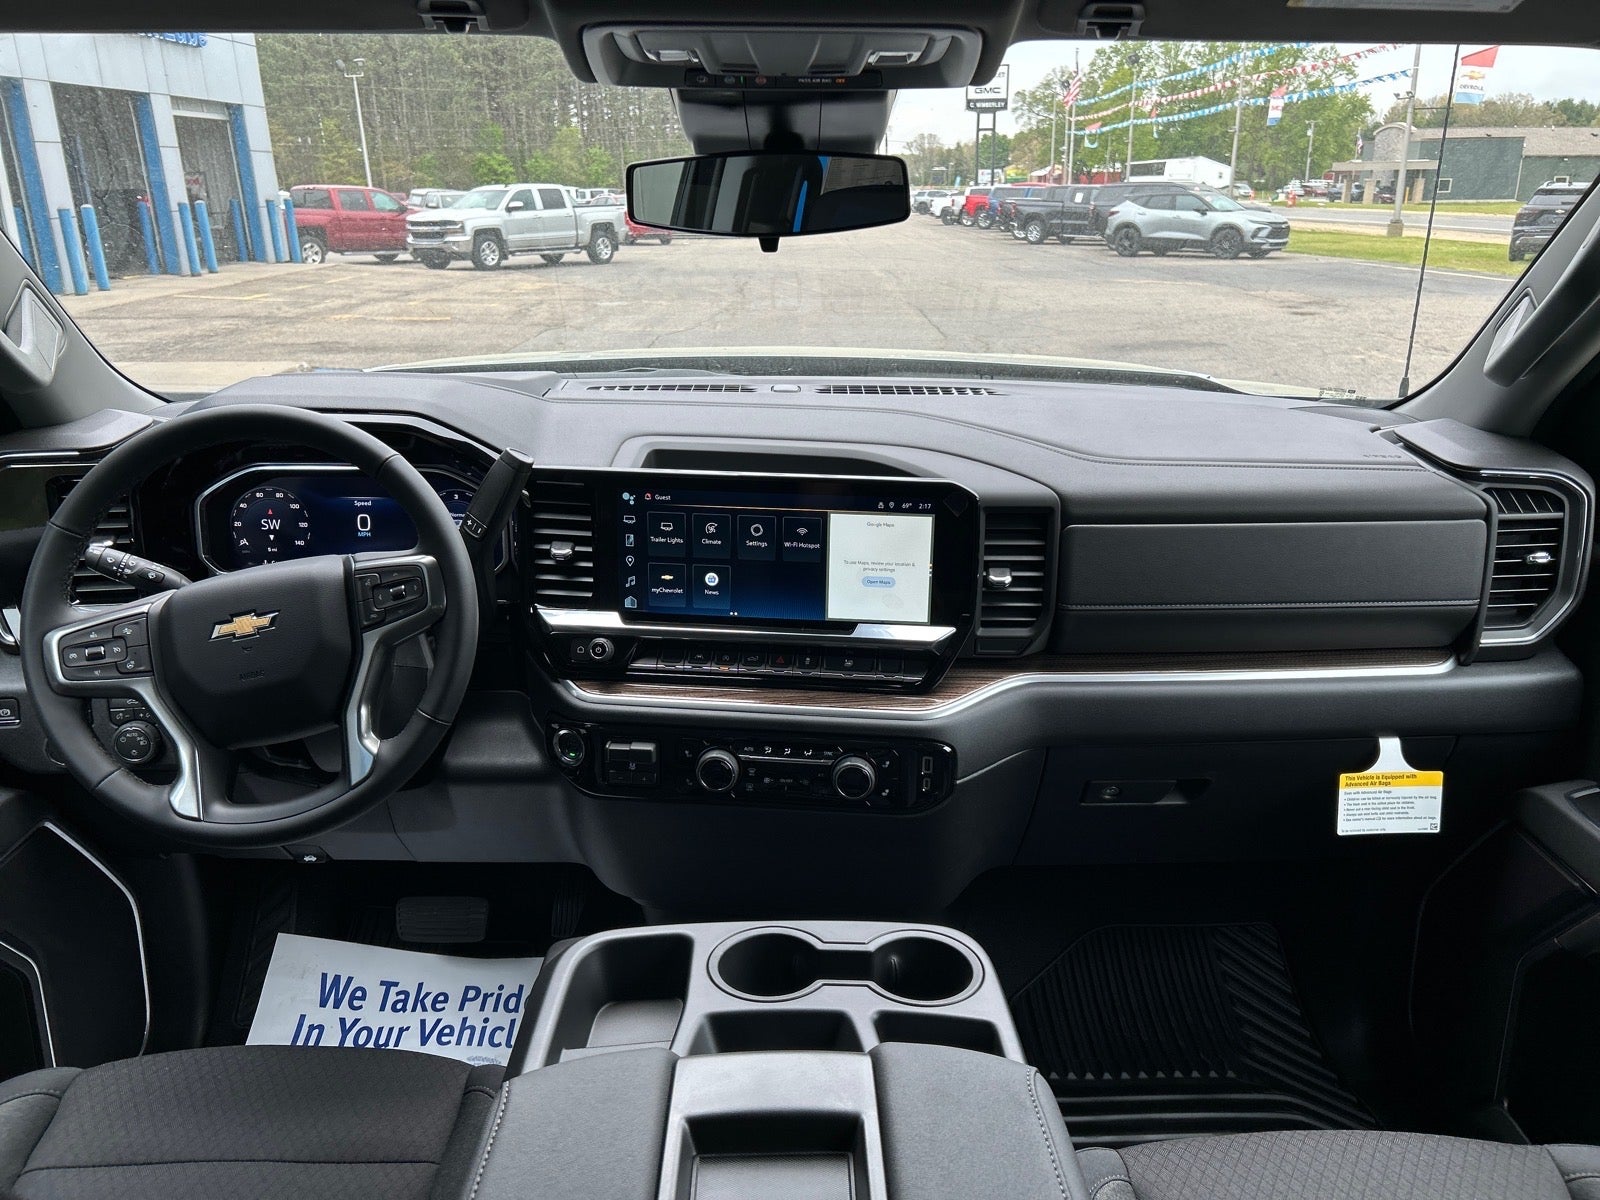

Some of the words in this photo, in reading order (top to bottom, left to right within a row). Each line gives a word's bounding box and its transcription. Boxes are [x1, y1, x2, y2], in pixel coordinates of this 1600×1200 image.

[261, 519, 280, 530] SW
[357, 514, 370, 531] 0
[318, 972, 367, 1012] We
[379, 980, 449, 1014] Take
[458, 984, 524, 1014] Prid
[290, 1014, 325, 1047] In
[338, 1017, 411, 1049] Your
[418, 1017, 517, 1049] Vehicl
